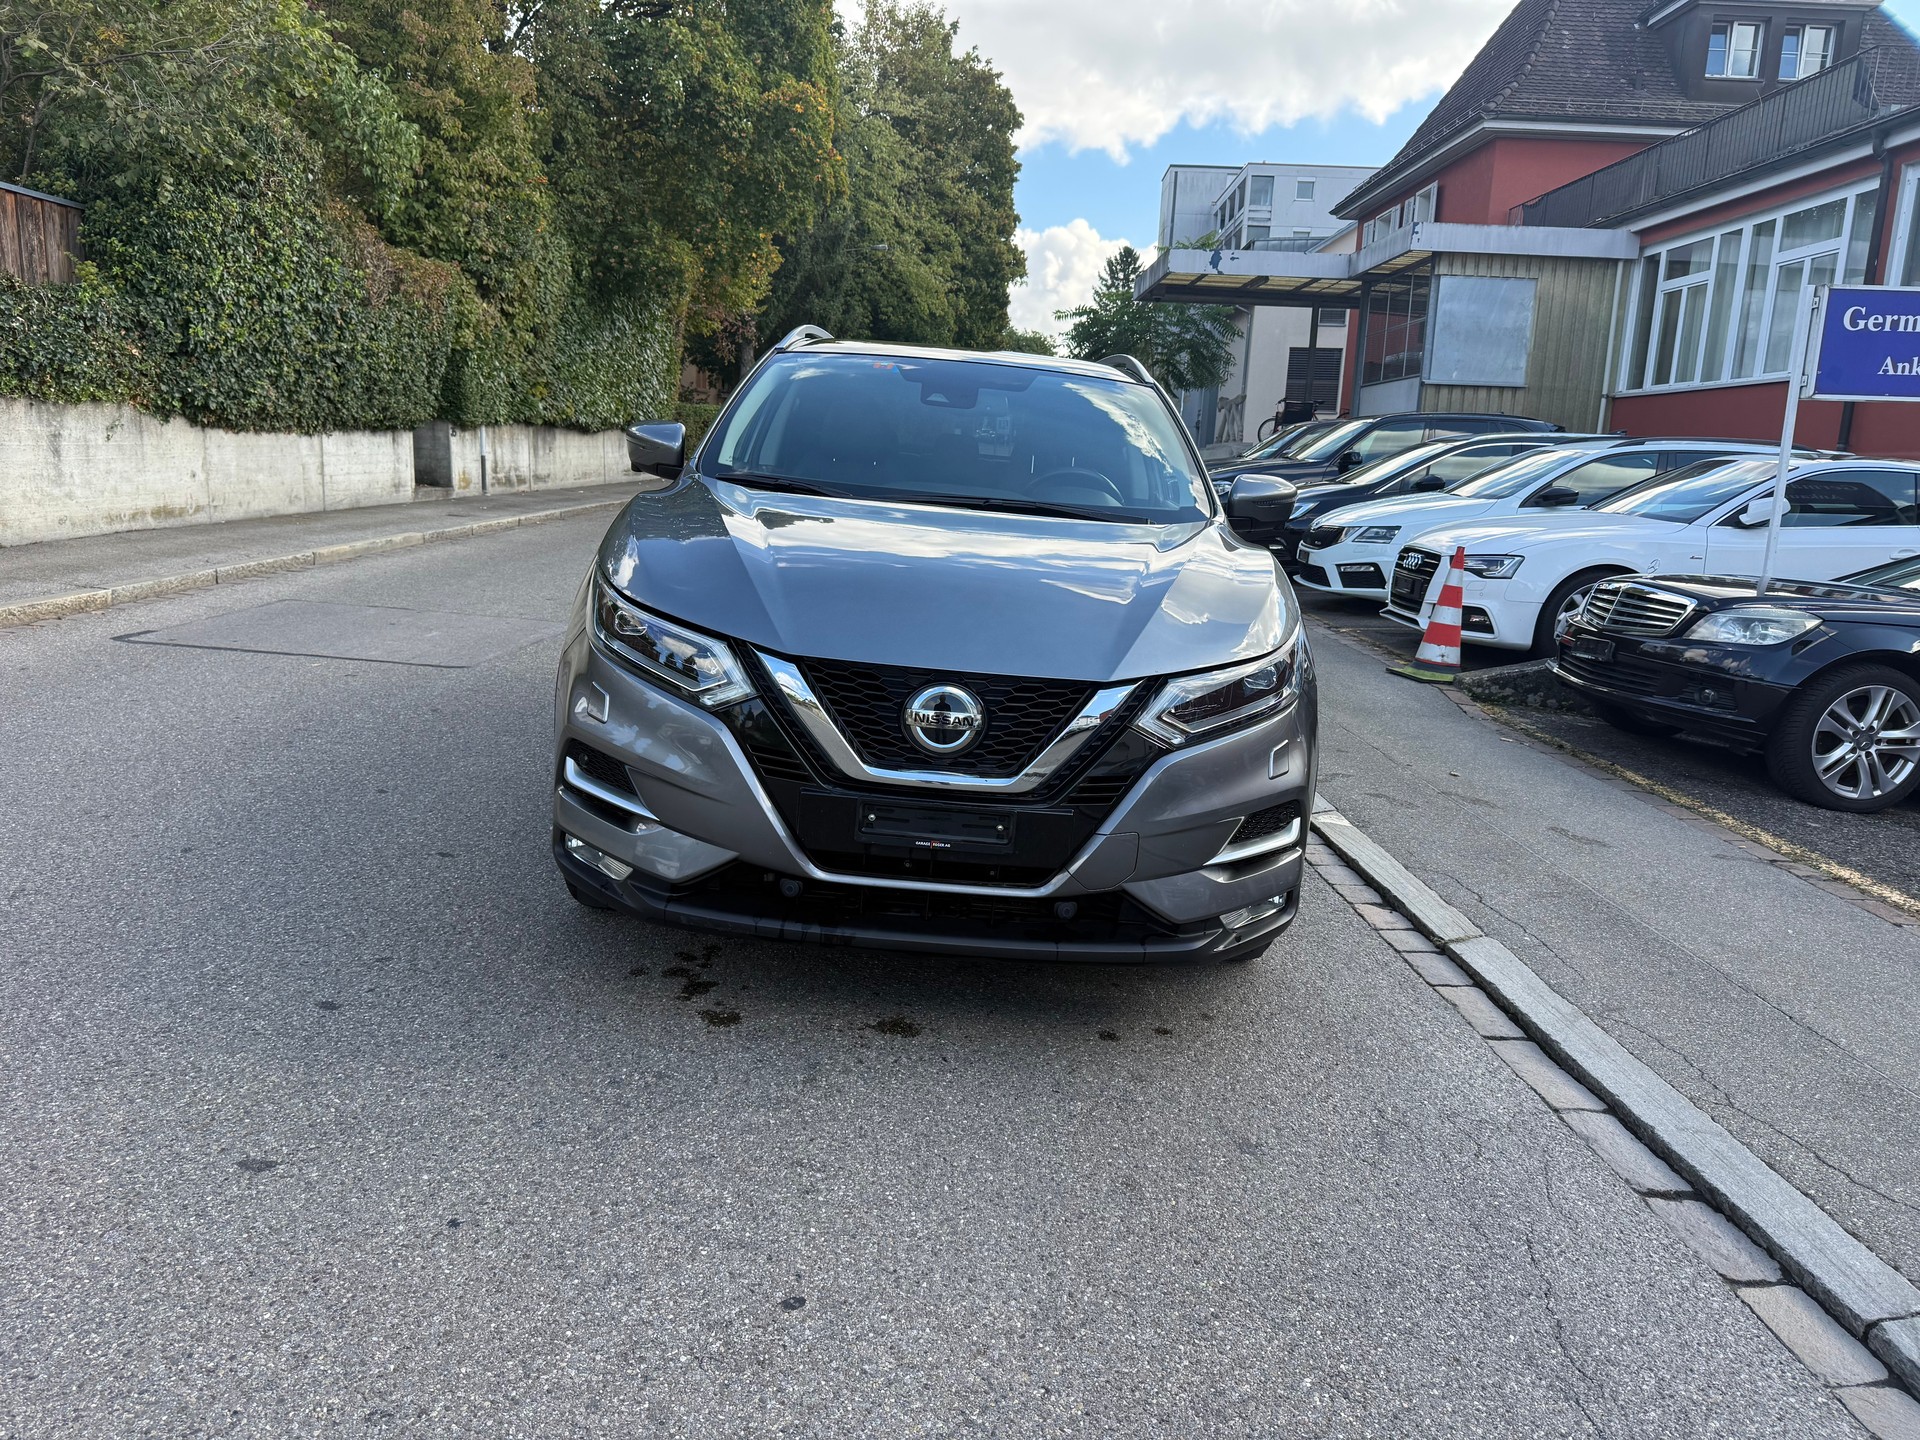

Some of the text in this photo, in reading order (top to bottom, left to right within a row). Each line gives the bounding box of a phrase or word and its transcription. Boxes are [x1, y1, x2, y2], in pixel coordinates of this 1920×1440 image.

[1843, 306, 1920, 332] Germ
[1877, 356, 1920, 376] Ank
[914, 712, 974, 727] NISSAN
